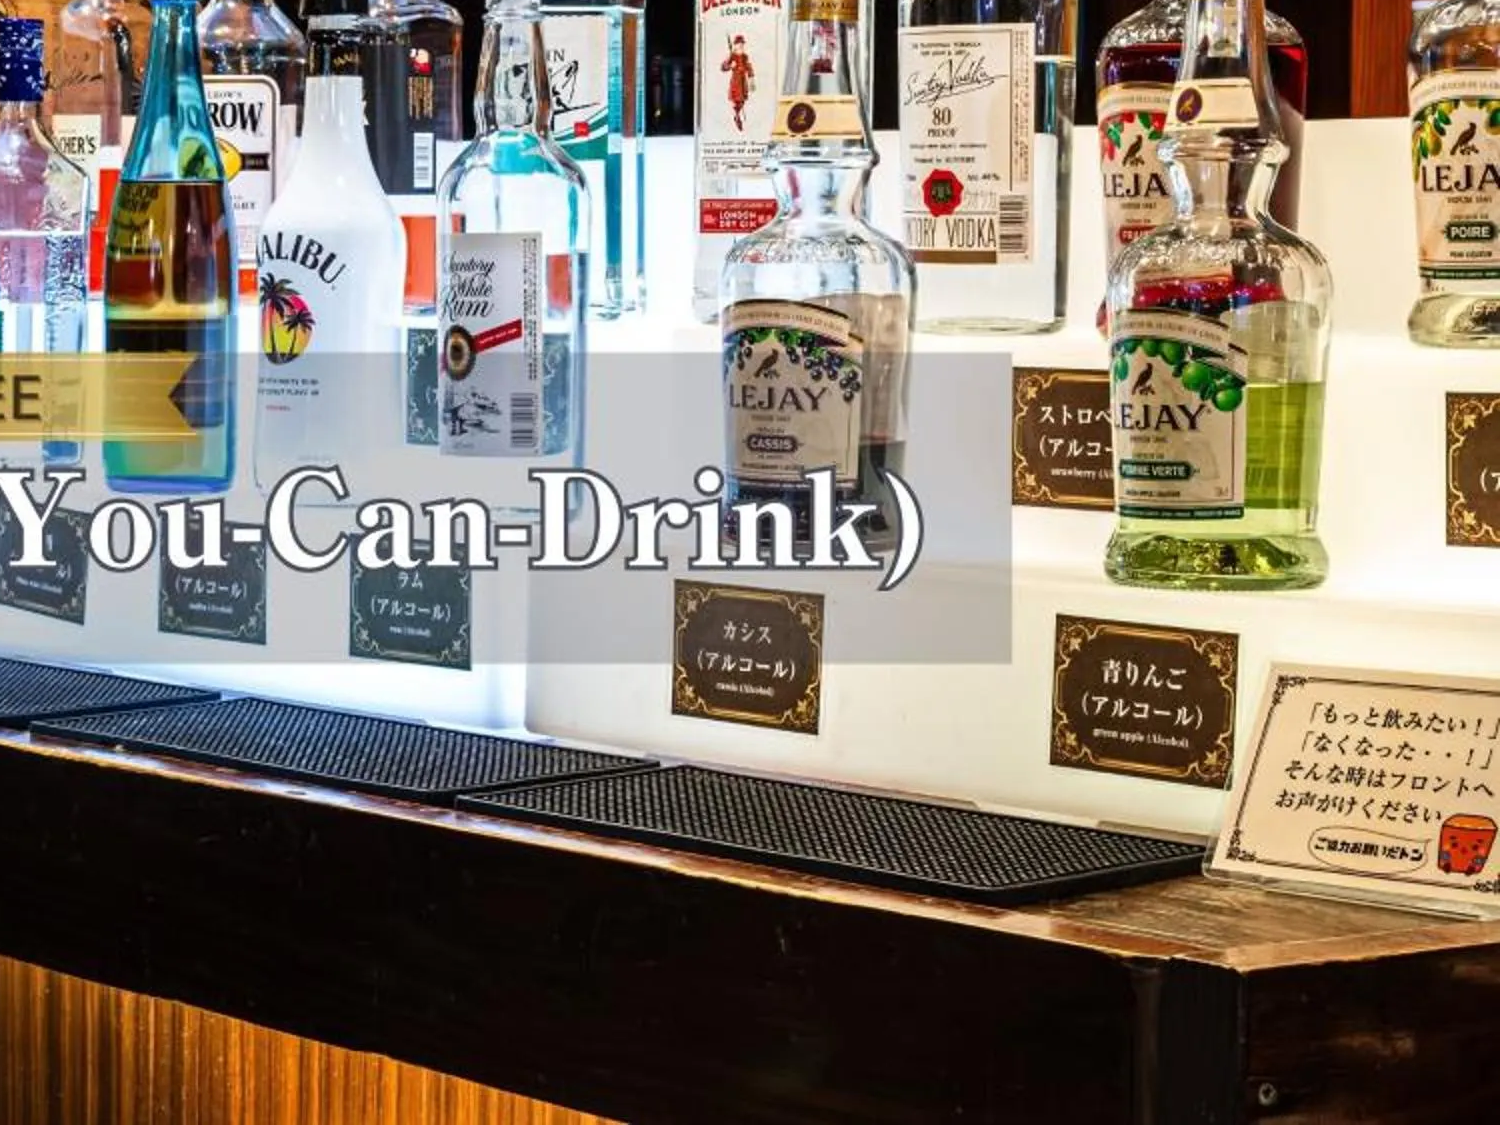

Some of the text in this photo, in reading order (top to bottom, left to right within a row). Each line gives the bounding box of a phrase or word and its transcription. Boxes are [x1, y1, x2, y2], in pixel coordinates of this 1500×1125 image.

[721, 7, 760, 17] LONDON
[932, 107, 952, 125] 80
[1103, 172, 1169, 198] LEJA
[1422, 163, 1500, 193] LEJA
[945, 217, 997, 248] VODKA
[1450, 225, 1490, 238] POIRE
[257, 231, 347, 285] ALIBU
[728, 383, 828, 412] LEJAY
[750, 437, 792, 450] CASSIS
[175, 575, 248, 601] (アルコール)
[370, 594, 451, 623] (アルコール)
[722, 620, 773, 644] カシス
[697, 648, 797, 683] (アルコール)
[1101, 658, 1187, 691] 青りんご
[1080, 690, 1204, 731] (アルコール)
[1284, 760, 1495, 798] そんな時はフロントへ
[1274, 789, 1443, 824] お声がけください
